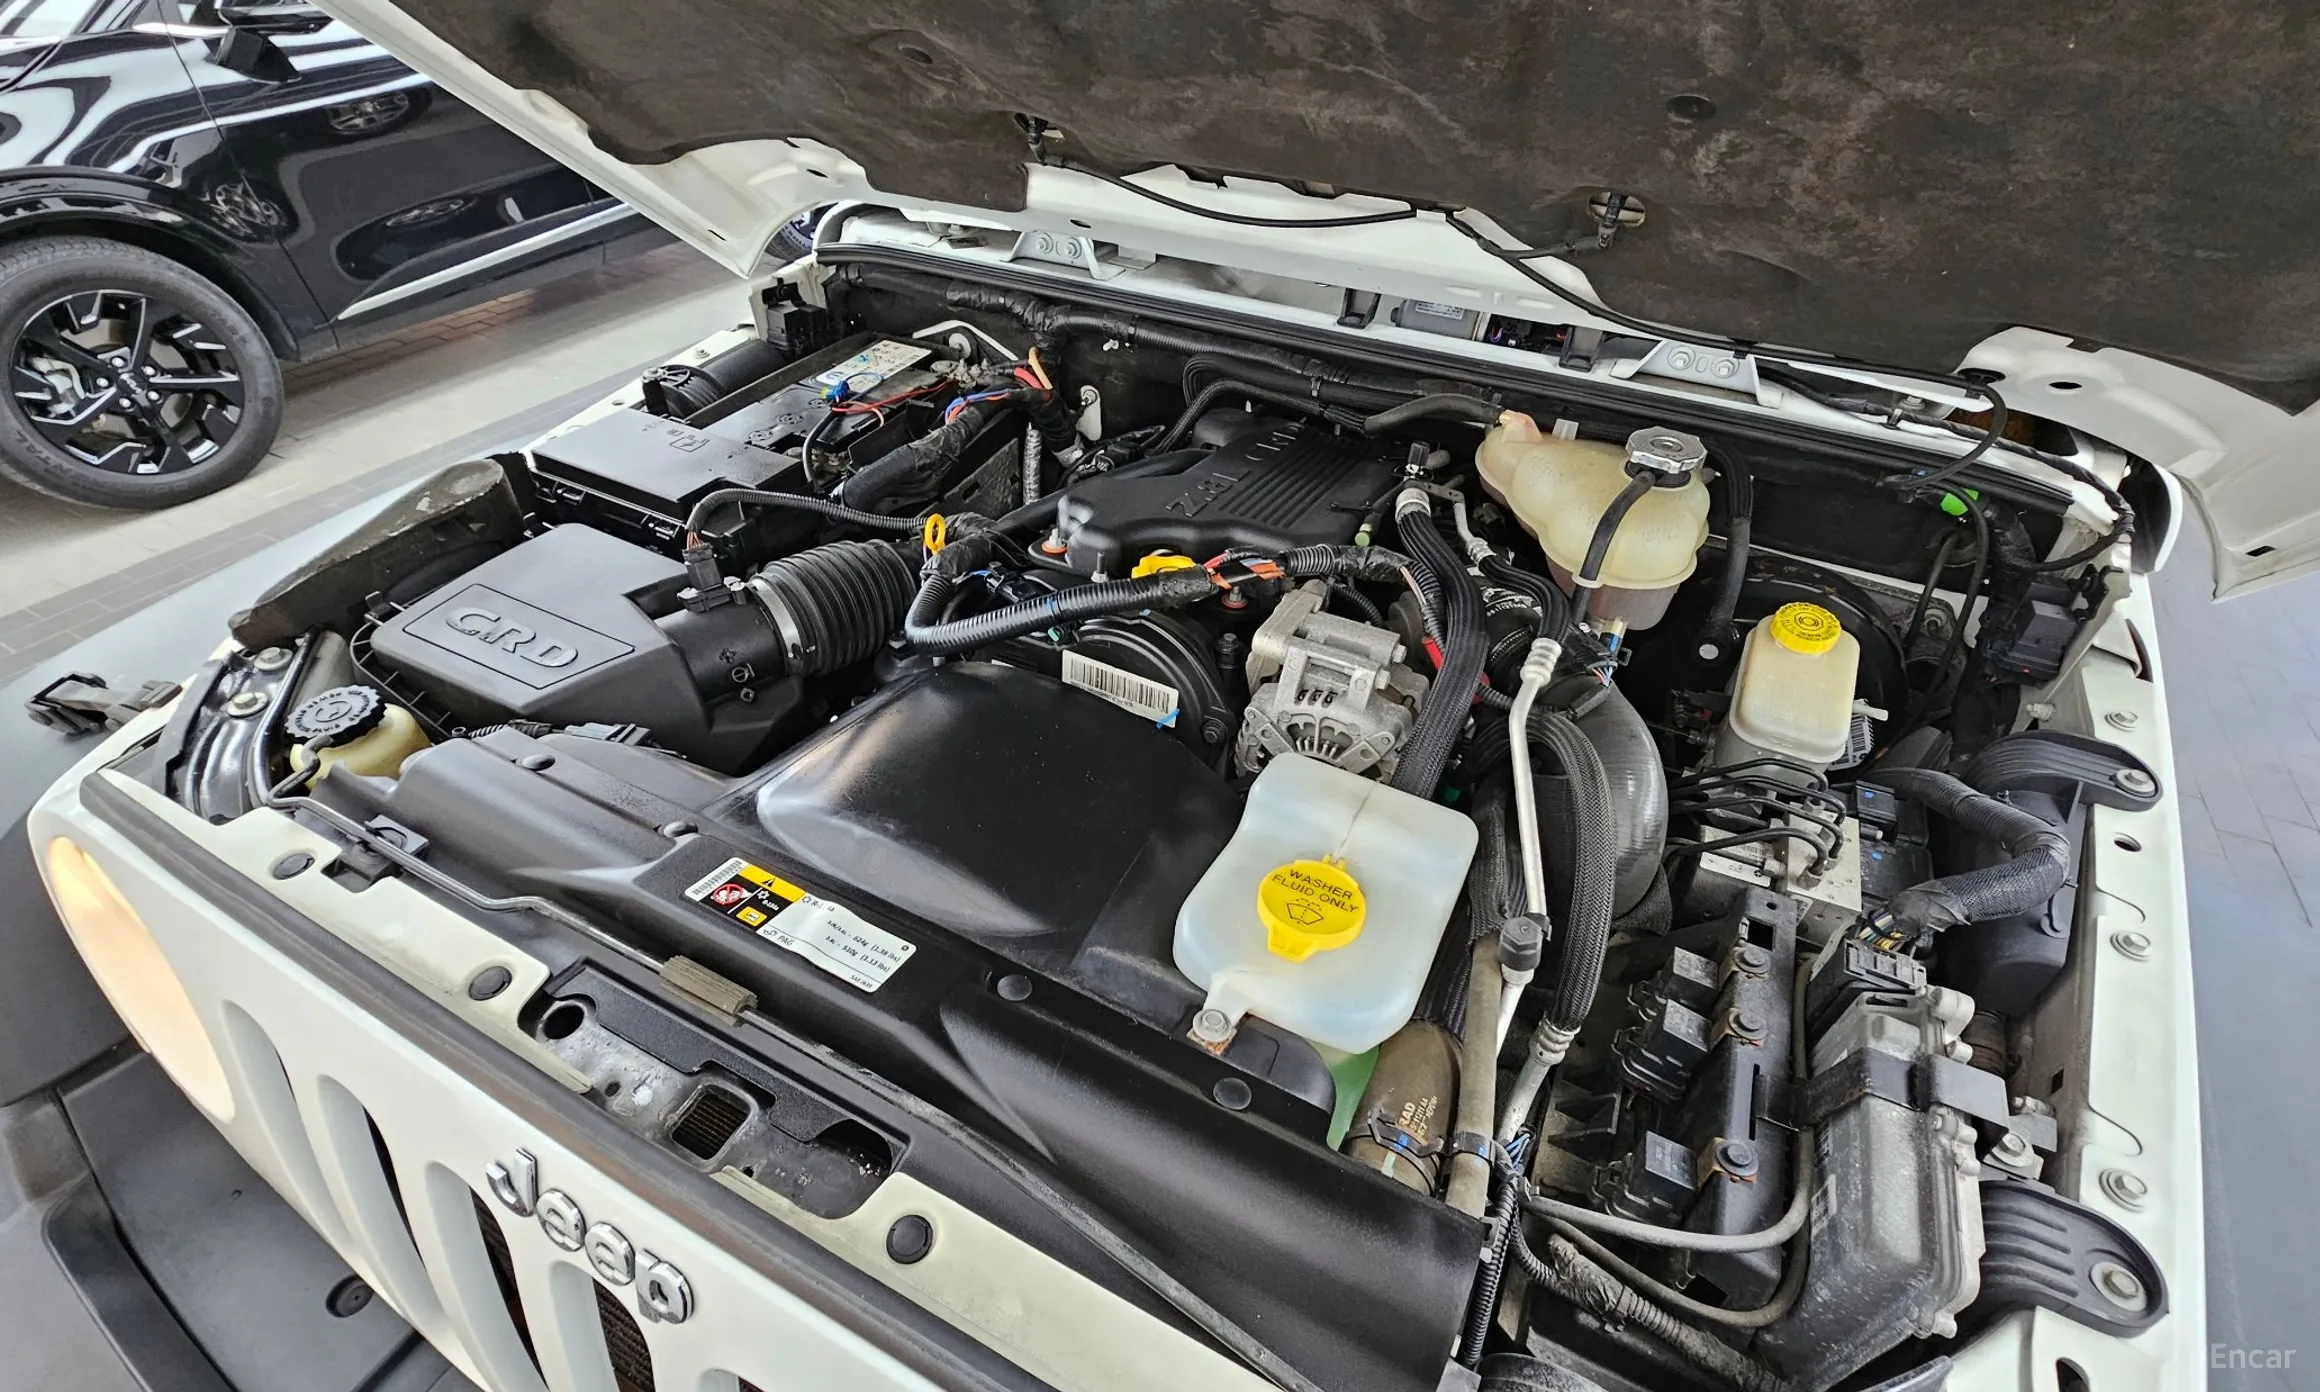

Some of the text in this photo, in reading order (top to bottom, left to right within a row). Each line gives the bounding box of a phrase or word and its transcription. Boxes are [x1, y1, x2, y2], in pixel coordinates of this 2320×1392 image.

[445, 606, 578, 668] CRD
[1271, 873, 1358, 914] FLUID ONLY
[1289, 868, 1353, 900] WASHER
[778, 935, 794, 946] PAG
[1398, 1102, 1416, 1127] RAD
[486, 1148, 695, 1324] Jeep
